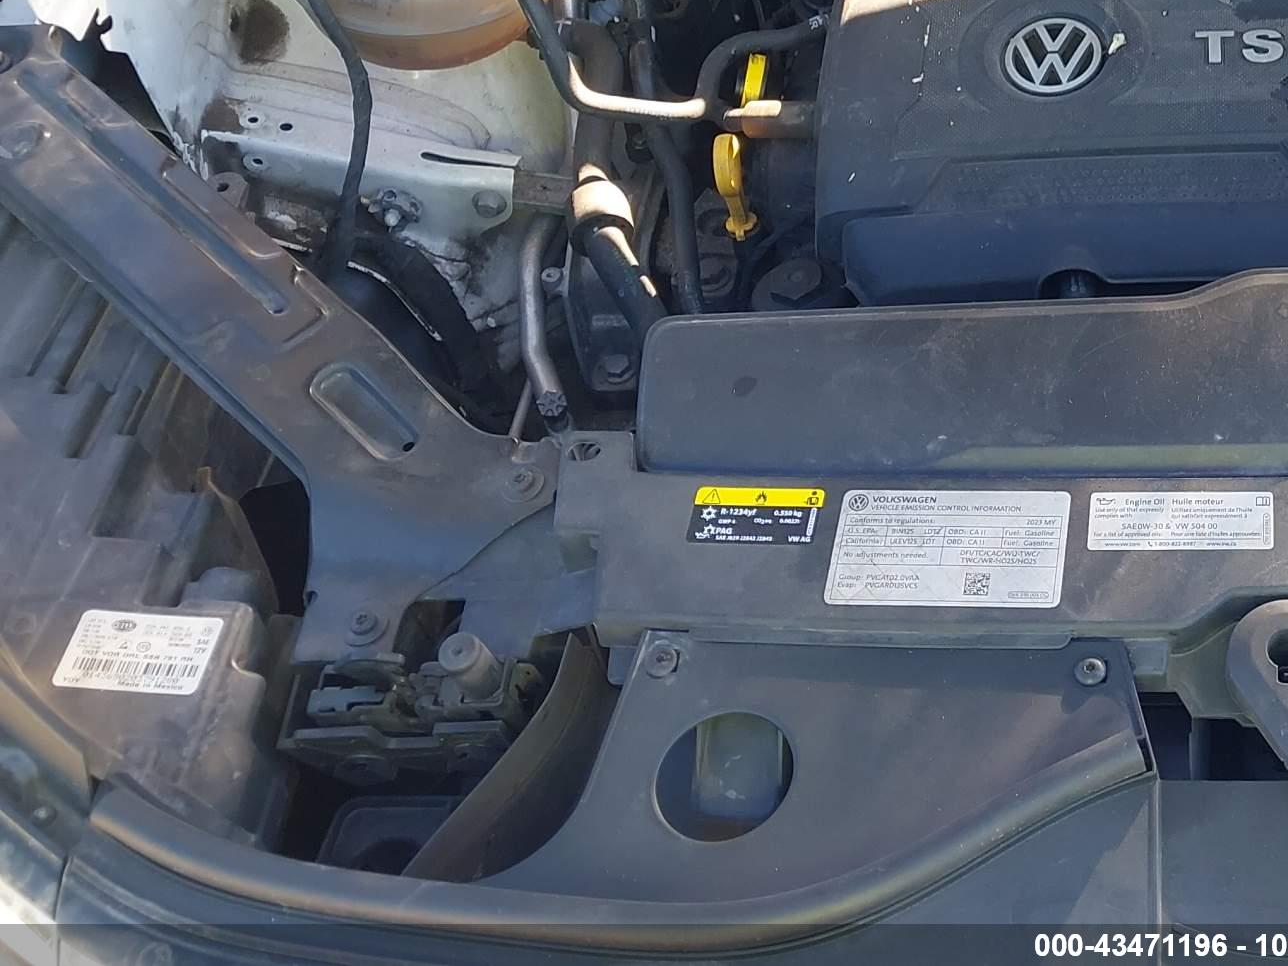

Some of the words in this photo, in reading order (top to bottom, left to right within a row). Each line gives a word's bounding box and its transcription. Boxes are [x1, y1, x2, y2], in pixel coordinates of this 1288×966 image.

[872, 495, 937, 504] VOLKSWAGEN
[1125, 498, 1152, 506] Engine
[720, 508, 757, 518] R-1234yf
[793, 509, 802, 518] kg
[1025, 529, 1055, 537] Gasoline
[1023, 539, 1054, 547] Gasoline
